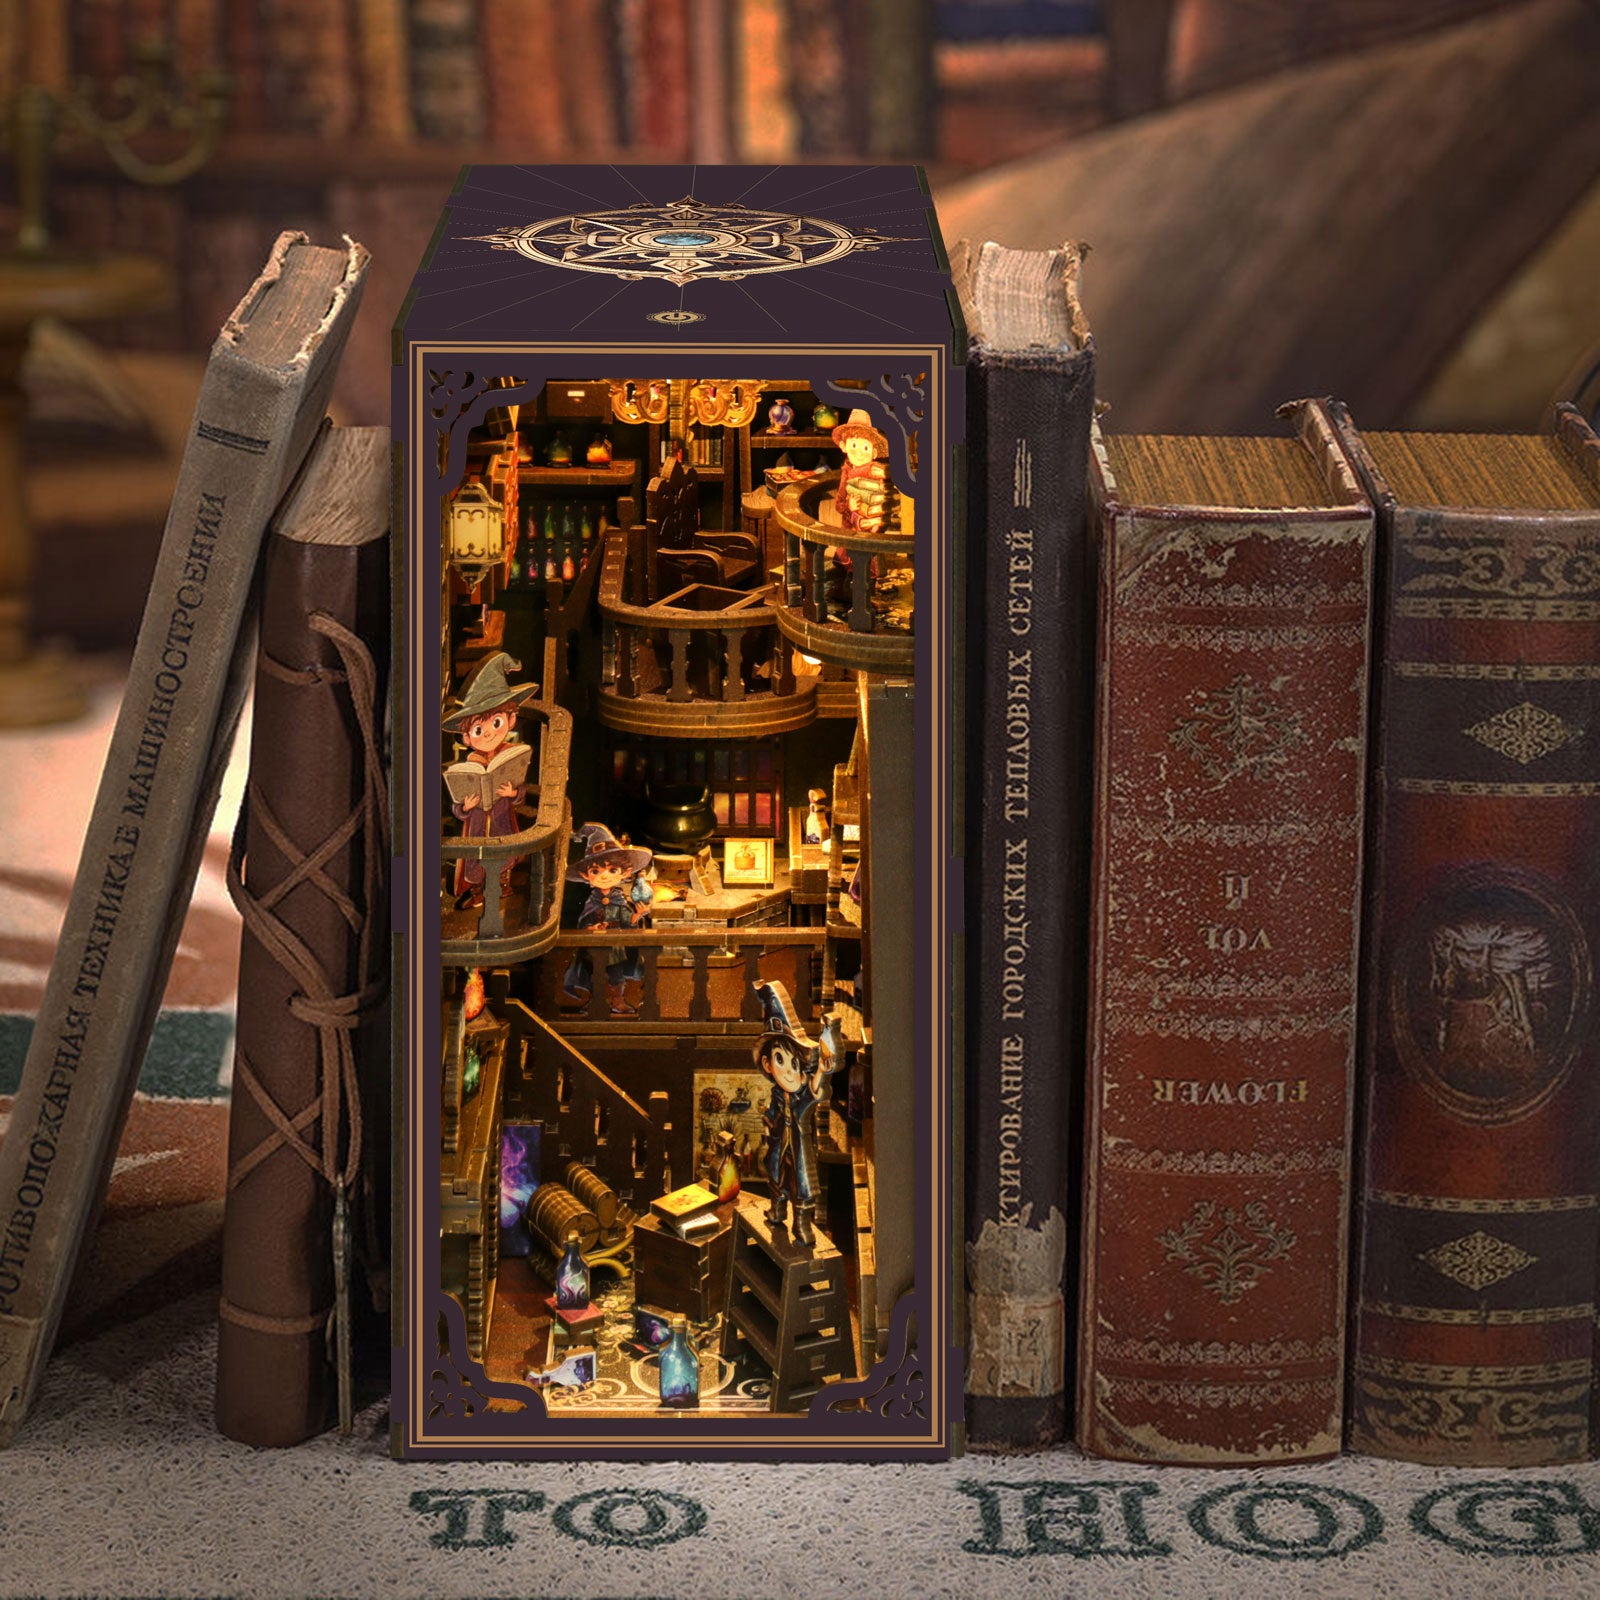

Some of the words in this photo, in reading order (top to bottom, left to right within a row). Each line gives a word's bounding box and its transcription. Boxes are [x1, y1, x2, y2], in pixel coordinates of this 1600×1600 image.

[1005, 529, 1033, 636] СЕТЕЙ
[75, 852, 132, 1000] ТЕХНИКА
[122, 493, 226, 818] МАШИНОСТРОЕНИИ
[1005, 650, 1032, 823] ТЕПЛОВЫХ
[1002, 838, 1031, 1020] ГОРОДСКИХ
[1152, 1078, 1308, 1105] FLOWER
[409, 1487, 708, 1548] TO
